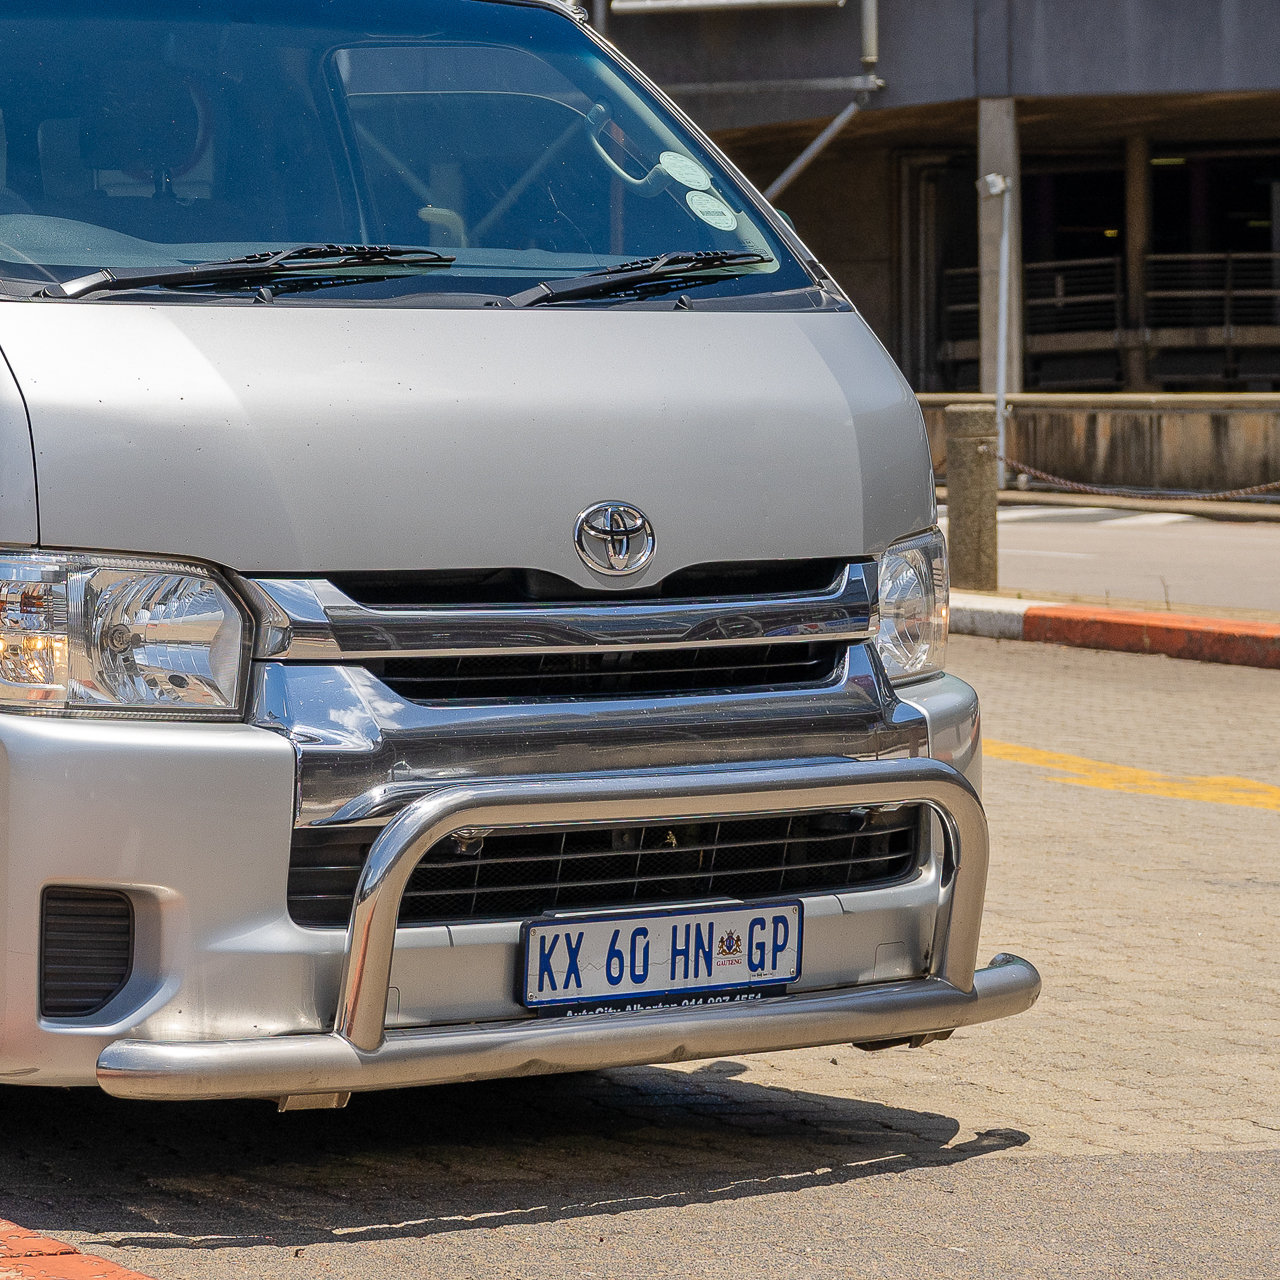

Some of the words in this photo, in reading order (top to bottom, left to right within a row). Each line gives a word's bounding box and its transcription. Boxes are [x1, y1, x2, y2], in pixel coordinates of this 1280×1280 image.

[537, 931, 584, 992] KX
[605, 927, 650, 986] 60
[670, 922, 714, 980] HN
[747, 915, 789, 972] GP
[716, 958, 742, 967] GAUTENG
